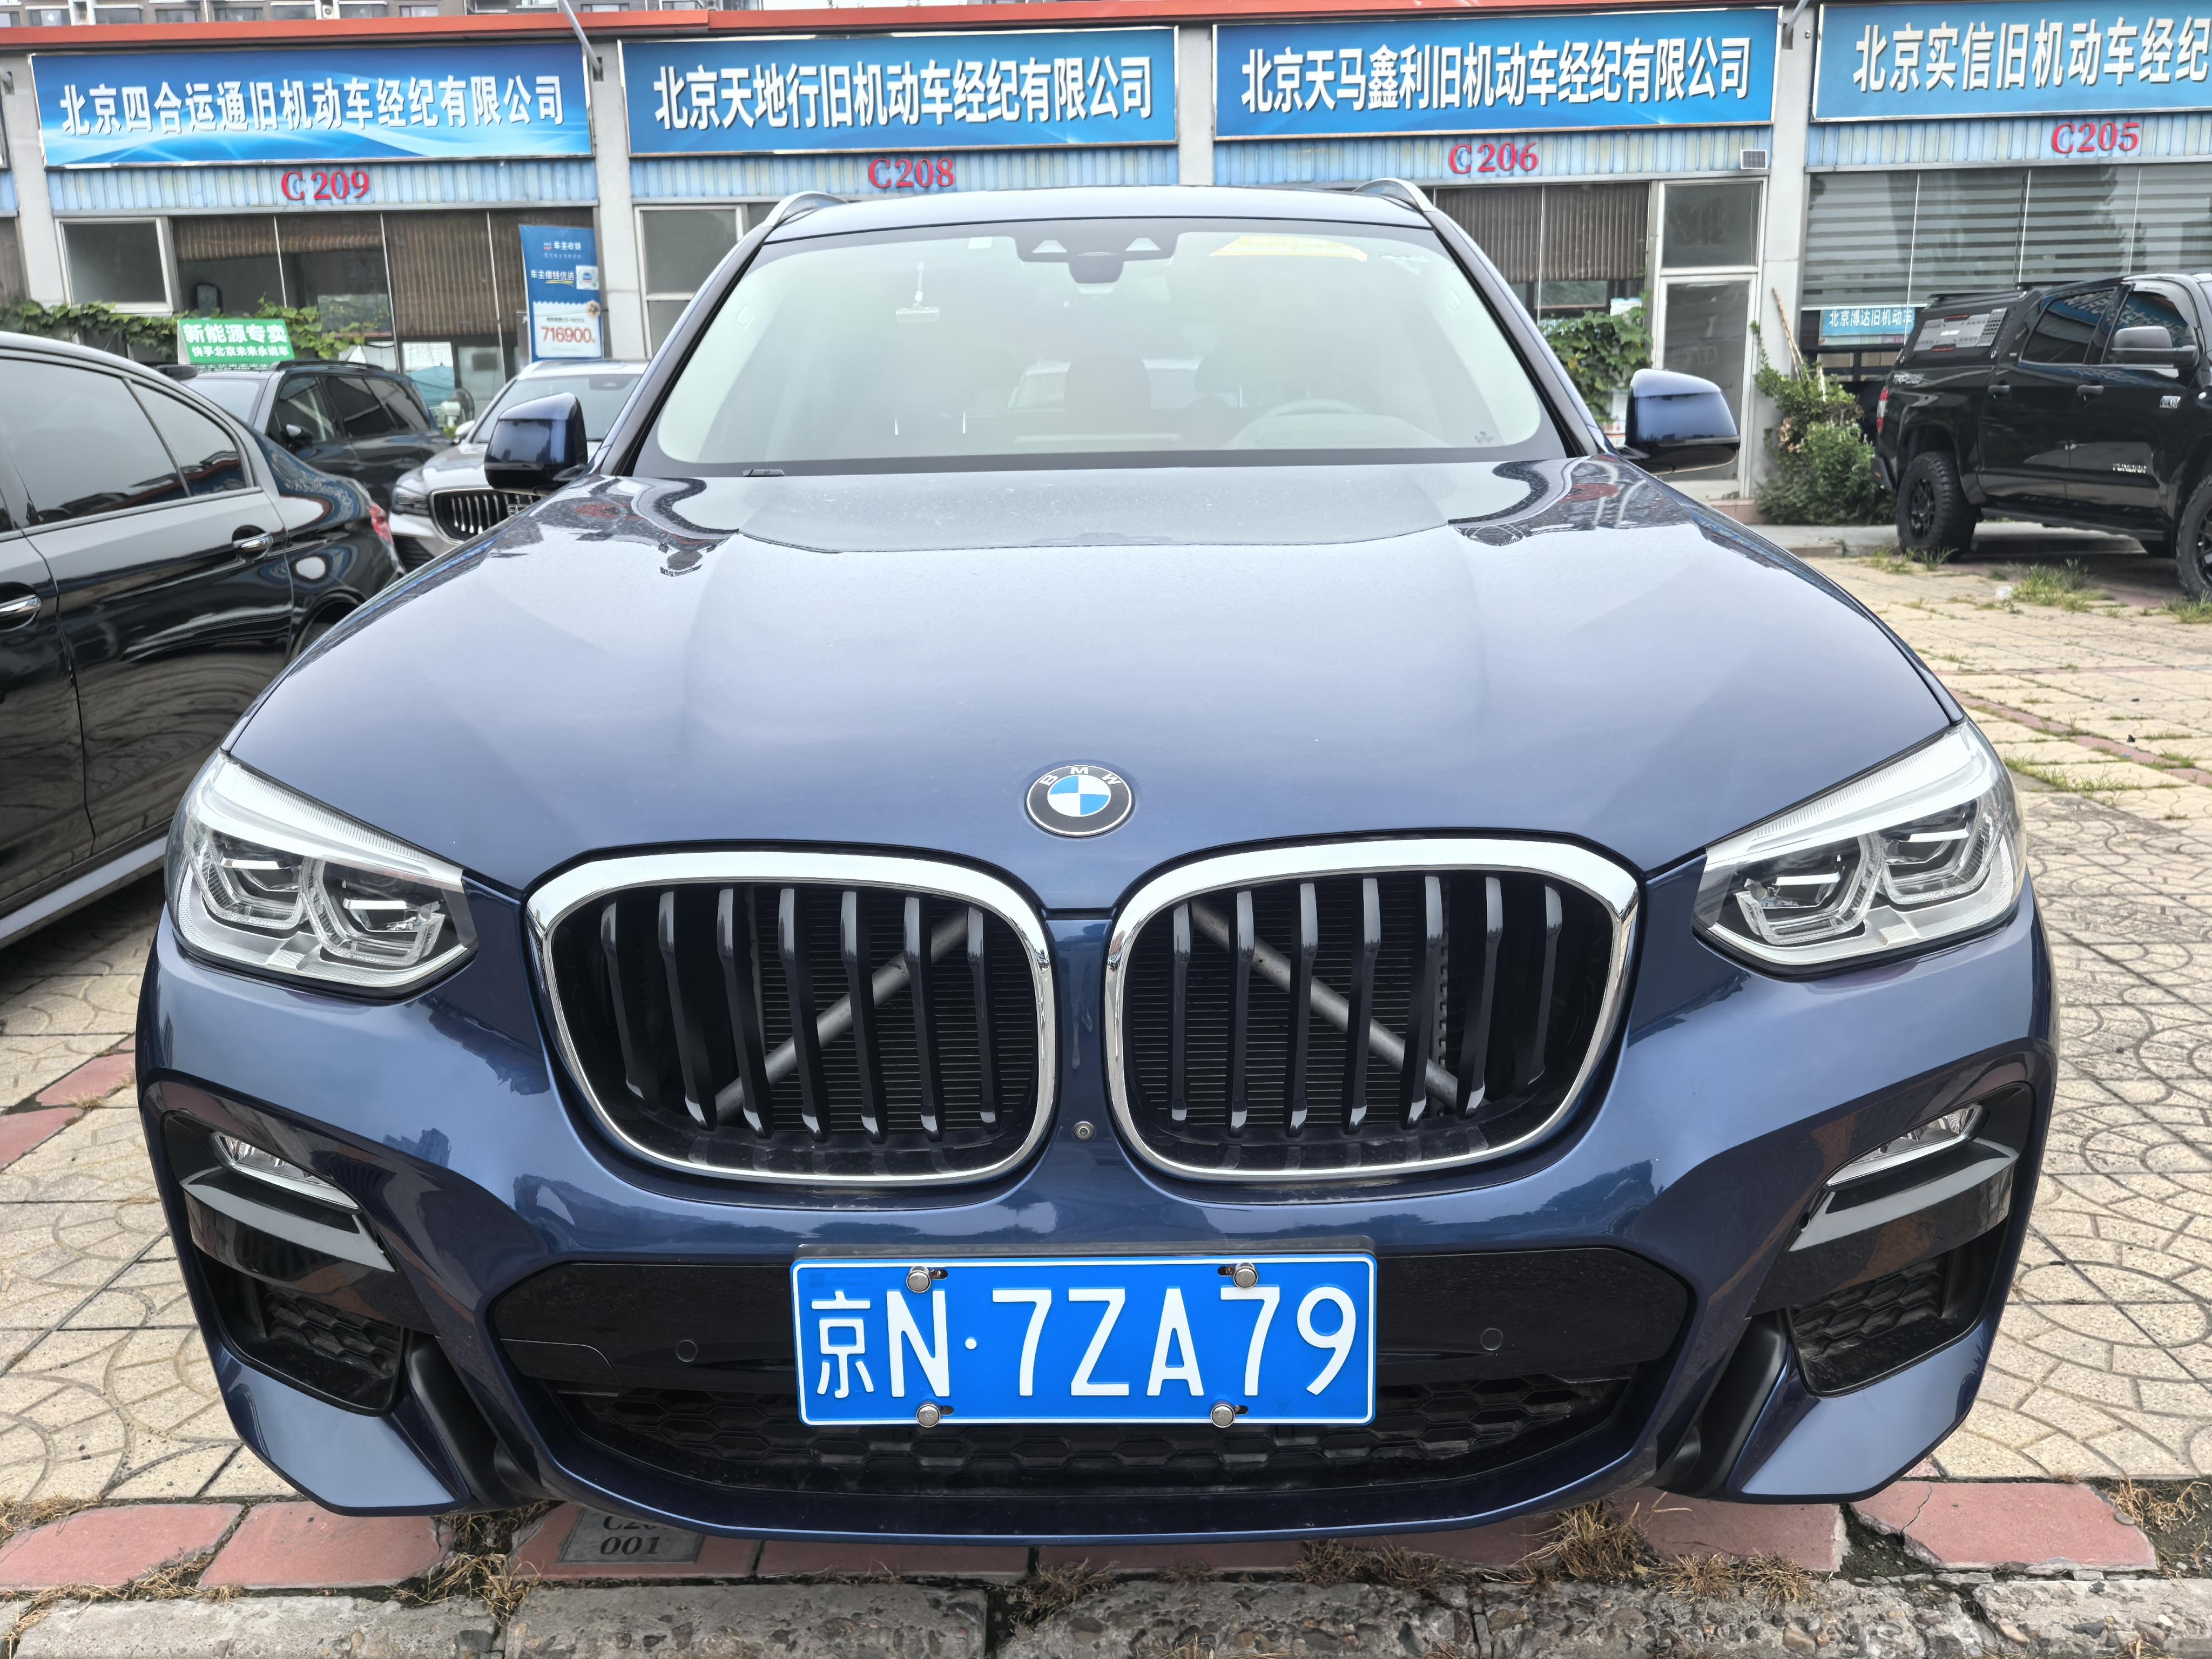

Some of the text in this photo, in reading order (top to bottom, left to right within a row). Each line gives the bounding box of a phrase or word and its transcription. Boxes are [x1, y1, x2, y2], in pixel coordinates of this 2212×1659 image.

[1853, 15, 2211, 92] 北京实信旧机动车经纪
[1242, 37, 1751, 113] 北京天马鑫利旧机动车经纪有限公司
[60, 75, 564, 136] 北京四合运通旧机动车经纪有限公司
[654, 56, 1151, 130] 北京天地行旧机动车经纪有限公司
[2052, 122, 2140, 154] C205
[868, 158, 955, 189] C208
[1448, 141, 1539, 174] C206
[281, 170, 370, 201] C209
[183, 323, 288, 343] 新能源专卖
[1038, 766, 1122, 786] BMW
[811, 1286, 1356, 1398] 京N·7ZA79
[600, 1536, 660, 1555] 001
